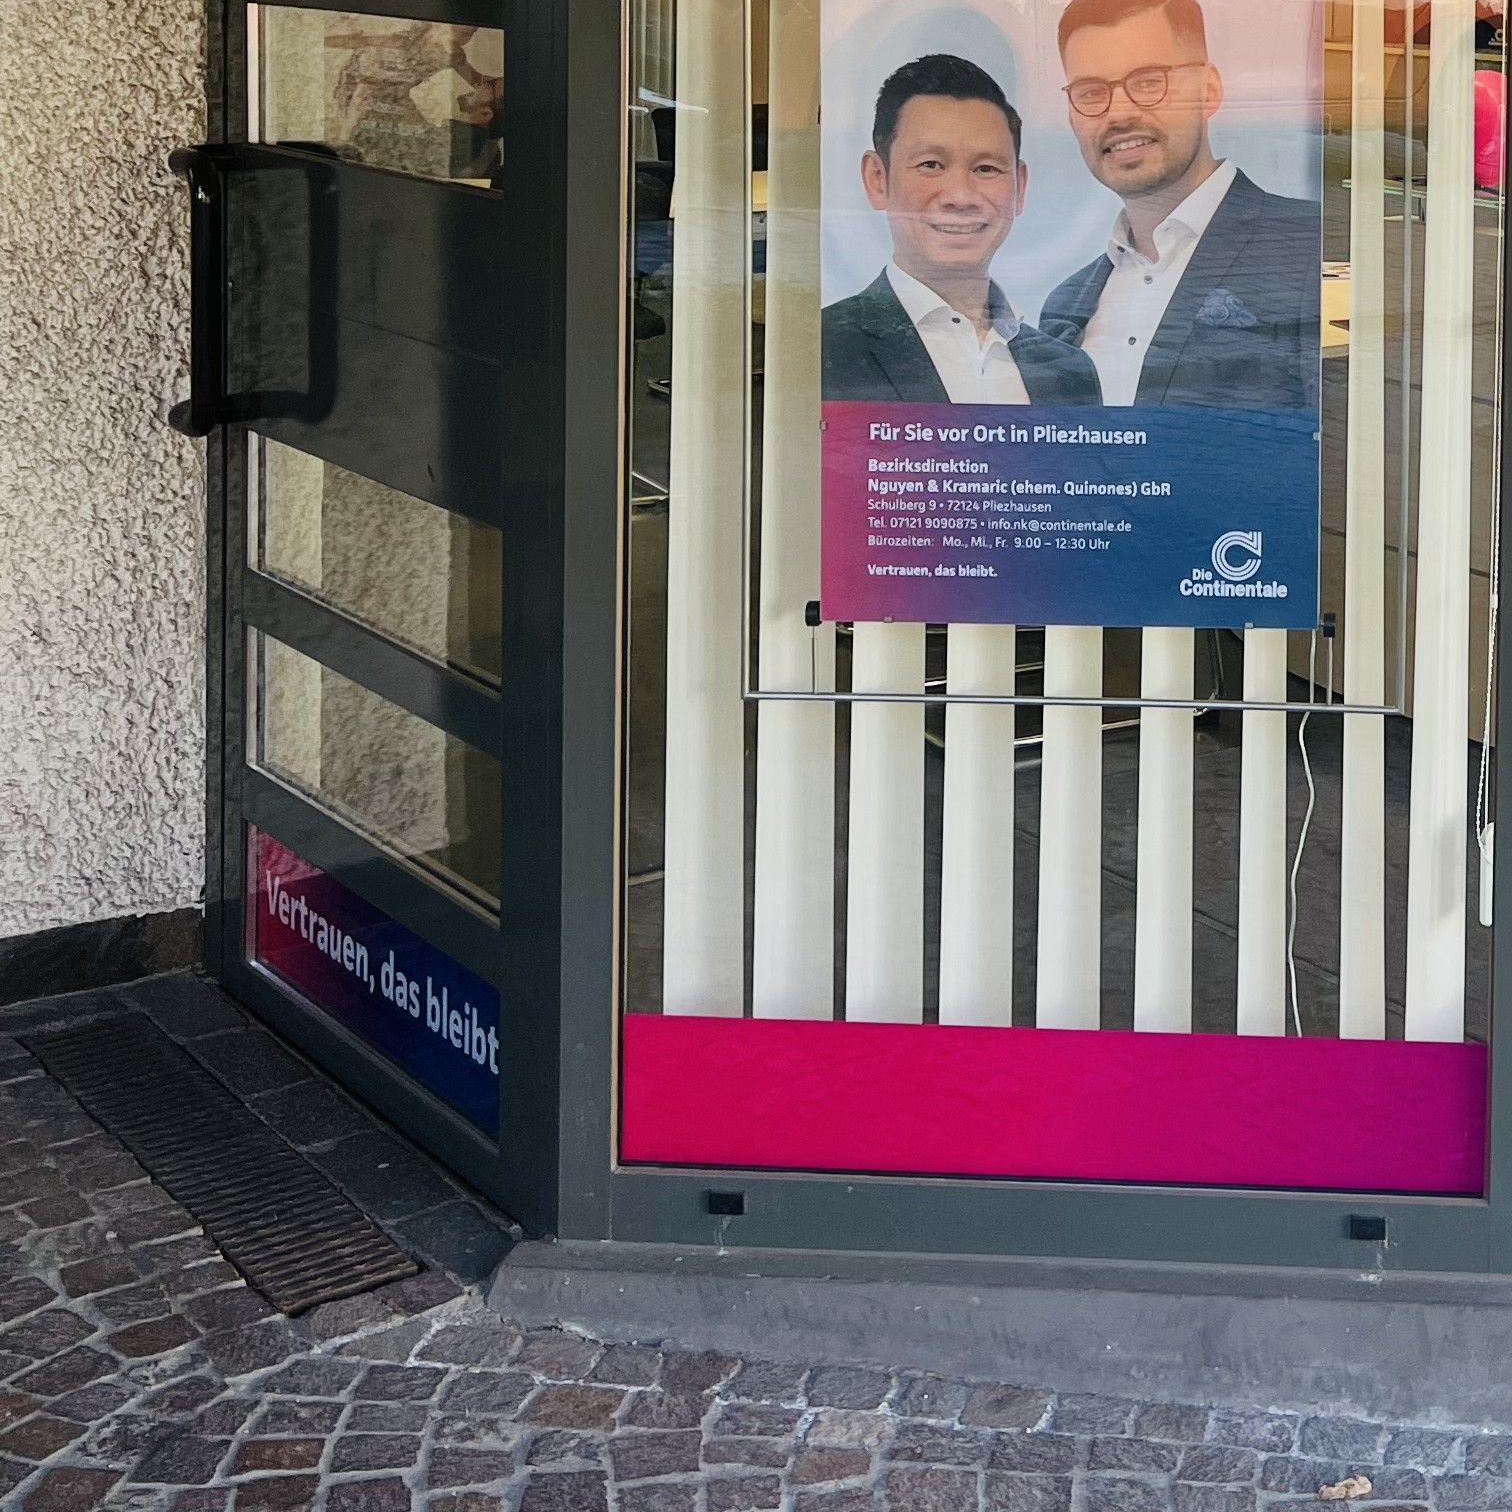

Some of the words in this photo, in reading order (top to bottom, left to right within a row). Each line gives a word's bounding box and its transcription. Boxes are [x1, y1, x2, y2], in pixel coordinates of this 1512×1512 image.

[869, 422, 900, 441] Für
[904, 422, 934, 442] Sie
[938, 428, 969, 442] vor
[973, 424, 1006, 443] Ort
[1010, 424, 1028, 443] in
[1033, 424, 1147, 445] Pliezhausen
[868, 457, 989, 474] Bezirksdirektion
[868, 478, 924, 495] Nguyen
[927, 479, 939, 493] &
[942, 479, 1008, 494] Kramaric
[1011, 480, 1061, 496] (ehem.
[1064, 481, 1138, 497] Quinones)
[1140, 481, 1171, 496] GbR
[867, 498, 926, 513] Schulberg
[928, 499, 937, 511] 9
[947, 499, 980, 511] 72124
[982, 500, 1052, 513] Pliezhausen
[889, 517, 922, 529] 07121
[924, 517, 978, 529] 9090875
[987, 518, 1132, 532] info.nk@continentale.de
[867, 534, 934, 547] Bürozeiten:
[1055, 537, 1086, 549] 12:30
[1088, 537, 1111, 550] Uhr
[867, 563, 933, 578] Vertrauen,
[934, 563, 956, 577] das
[958, 564, 998, 578] bleibt.
[1192, 568, 1213, 581] Die
[1179, 578, 1288, 598] Continentale
[265, 870, 375, 994] Vertrauen,
[380, 949, 421, 1019] das
